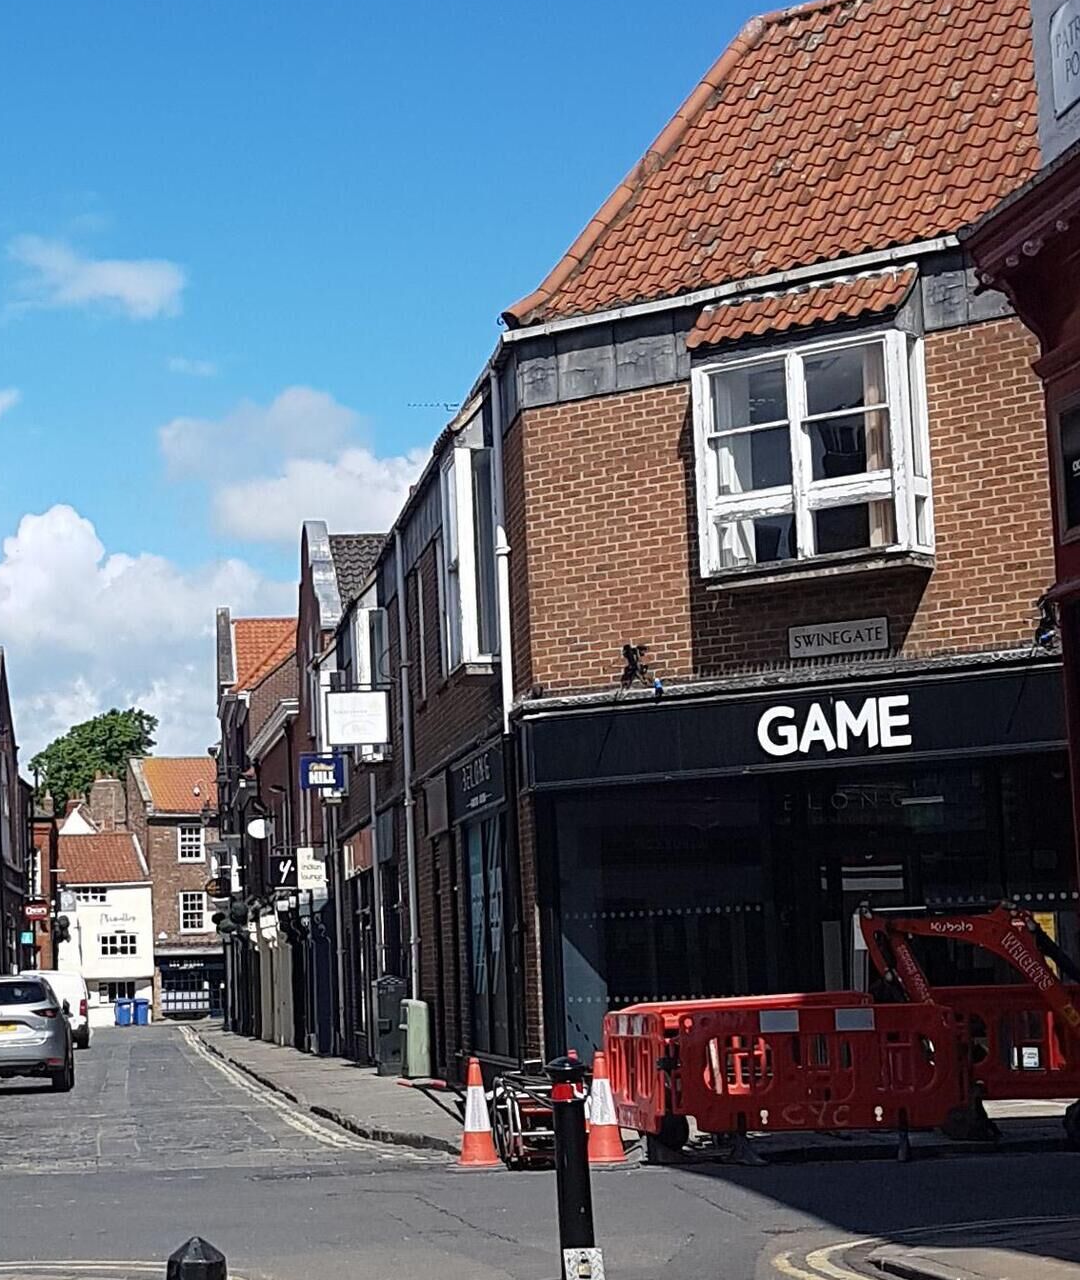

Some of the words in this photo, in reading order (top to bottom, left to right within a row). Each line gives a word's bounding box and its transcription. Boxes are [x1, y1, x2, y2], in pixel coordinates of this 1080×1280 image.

[793, 626, 884, 649] SWINEGATE
[757, 694, 913, 756] GAME
[308, 770, 336, 785] HILL
[930, 920, 974, 933] Kubota
[1001, 931, 1055, 992] WRIGHTS
